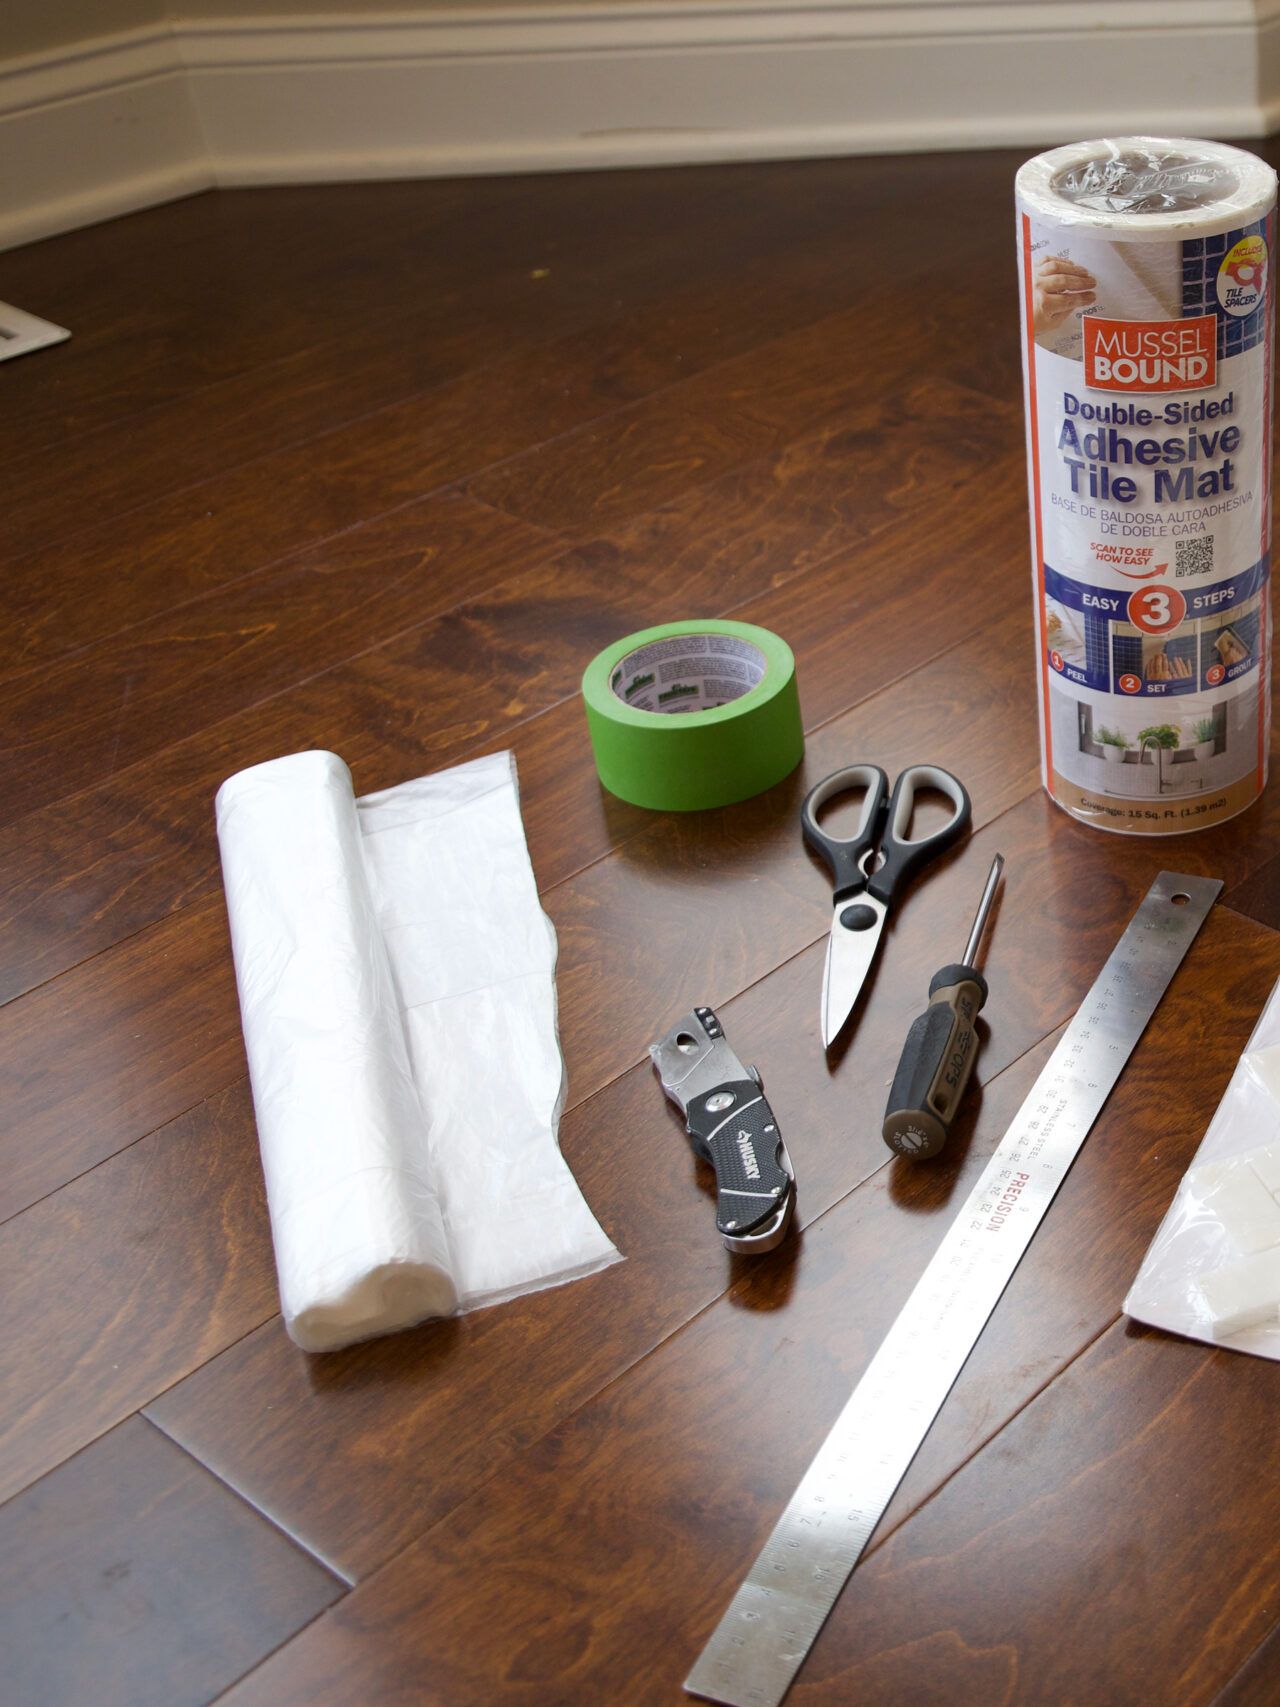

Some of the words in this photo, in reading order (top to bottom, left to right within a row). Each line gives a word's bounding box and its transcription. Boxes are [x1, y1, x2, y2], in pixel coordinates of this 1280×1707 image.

[1224, 293, 1257, 308] SPACERS
[1226, 287, 1243, 298] TILE
[1095, 328, 1207, 357] MUSSEL
[1094, 355, 1208, 384] BOUND
[1063, 391, 1234, 426] Double-Sided
[1058, 418, 1241, 465] Adhesive
[1063, 456, 1137, 503] Tile
[1154, 458, 1235, 504] Mat
[1051, 493, 1077, 514] BASE
[1081, 504, 1097, 519] DE
[1101, 510, 1163, 524] BALDOSA
[1167, 491, 1254, 523] AUTOADHESIVA
[1101, 522, 1117, 534] DE
[1123, 524, 1168, 537] DOBLE
[1172, 522, 1206, 536] CARA
[1090, 542, 1116, 553] SCAN
[1119, 547, 1133, 556] TO
[1135, 548, 1154, 557] SEE
[1096, 553, 1122, 564] HOW
[1123, 557, 1150, 565] EASY
[1082, 593, 1119, 612] EASY
[1141, 592, 1171, 626] 3
[1193, 587, 1235, 609] STEPS
[1067, 667, 1088, 683] PEEL
[1147, 684, 1166, 693] SET
[1080, 798, 1125, 817] Coverage:
[1128, 810, 1142, 818] 15
[1181, 804, 1207, 818] (1.39
[1040, 1099, 1068, 1137] STAINLESS
[740, 1141, 761, 1179] HUSKY
[1027, 1138, 1046, 1160] STEEL
[986, 1171, 1031, 1232] PRECISION
[970, 1220, 983, 1231] 22
[980, 1203, 993, 1213] 23
